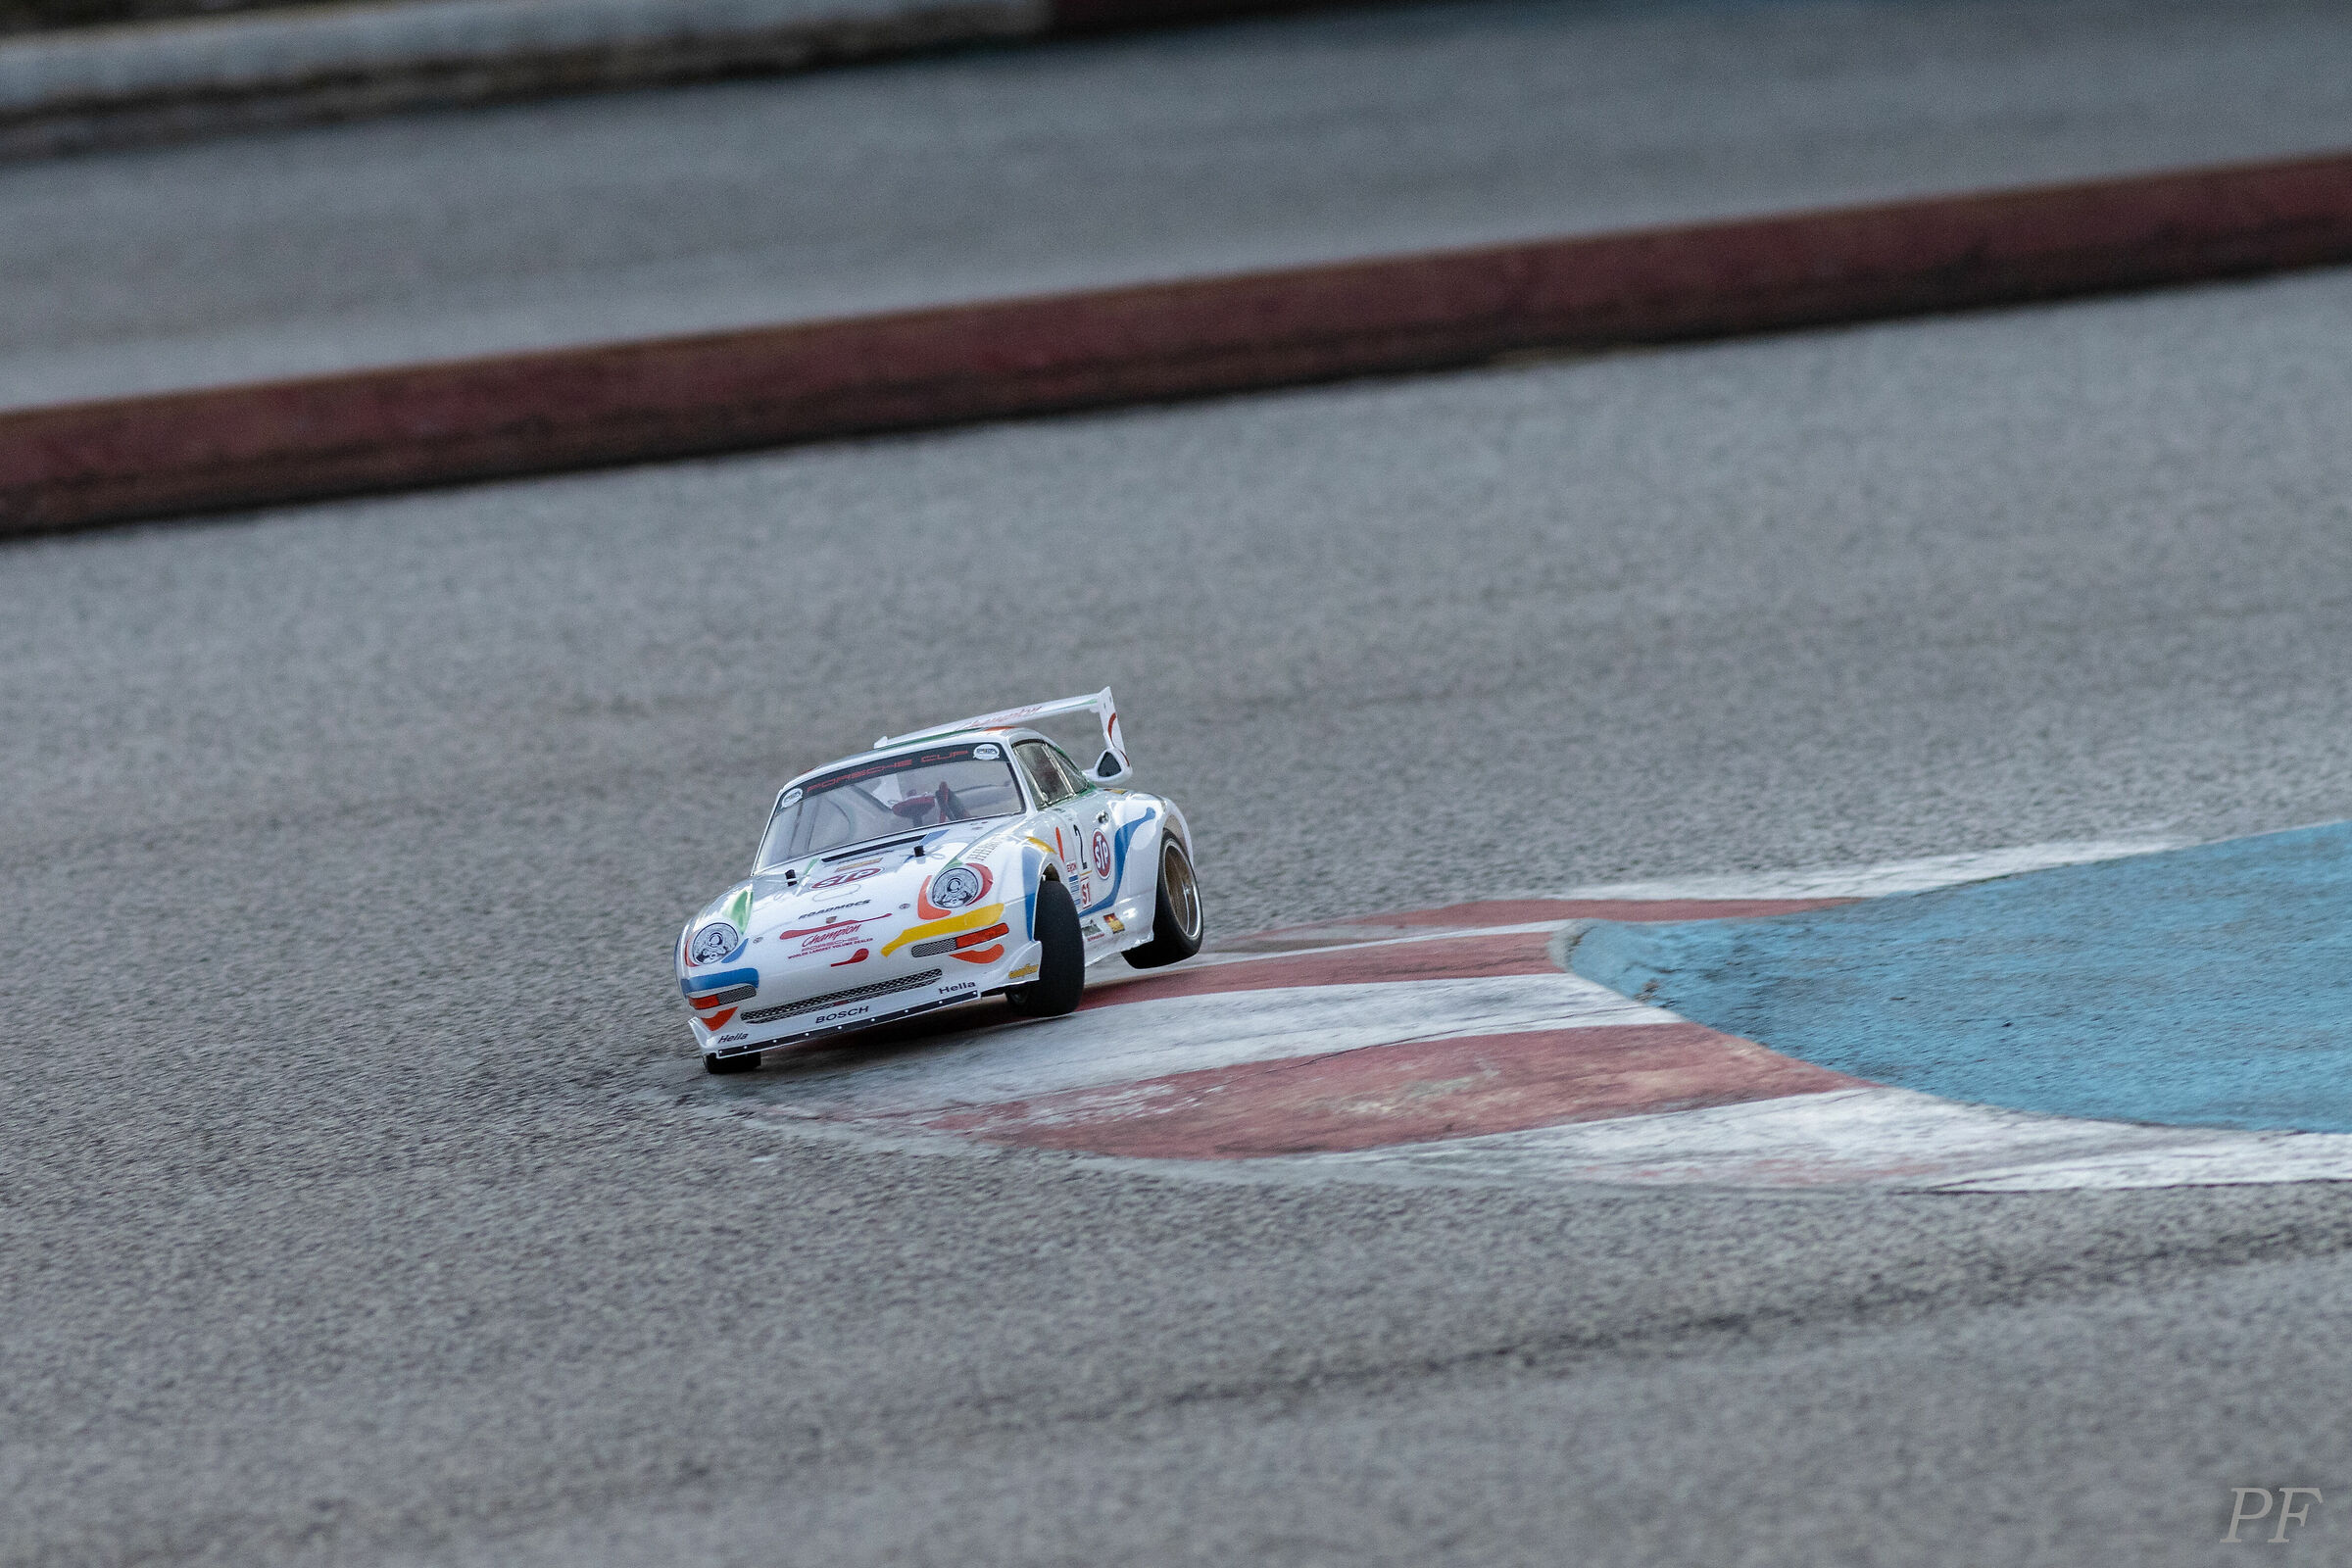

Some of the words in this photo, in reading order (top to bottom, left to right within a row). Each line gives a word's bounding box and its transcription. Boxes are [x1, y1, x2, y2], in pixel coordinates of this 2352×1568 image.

[807, 759, 912, 793] PORSCHE
[921, 750, 968, 763] CUP
[1073, 824, 1088, 870] 2
[1094, 833, 1109, 871] STP
[815, 867, 877, 888] STP
[802, 924, 861, 948] Champion
[938, 979, 976, 995] Hella
[815, 1005, 869, 1024] BOSCH
[717, 1031, 748, 1044] Hella
